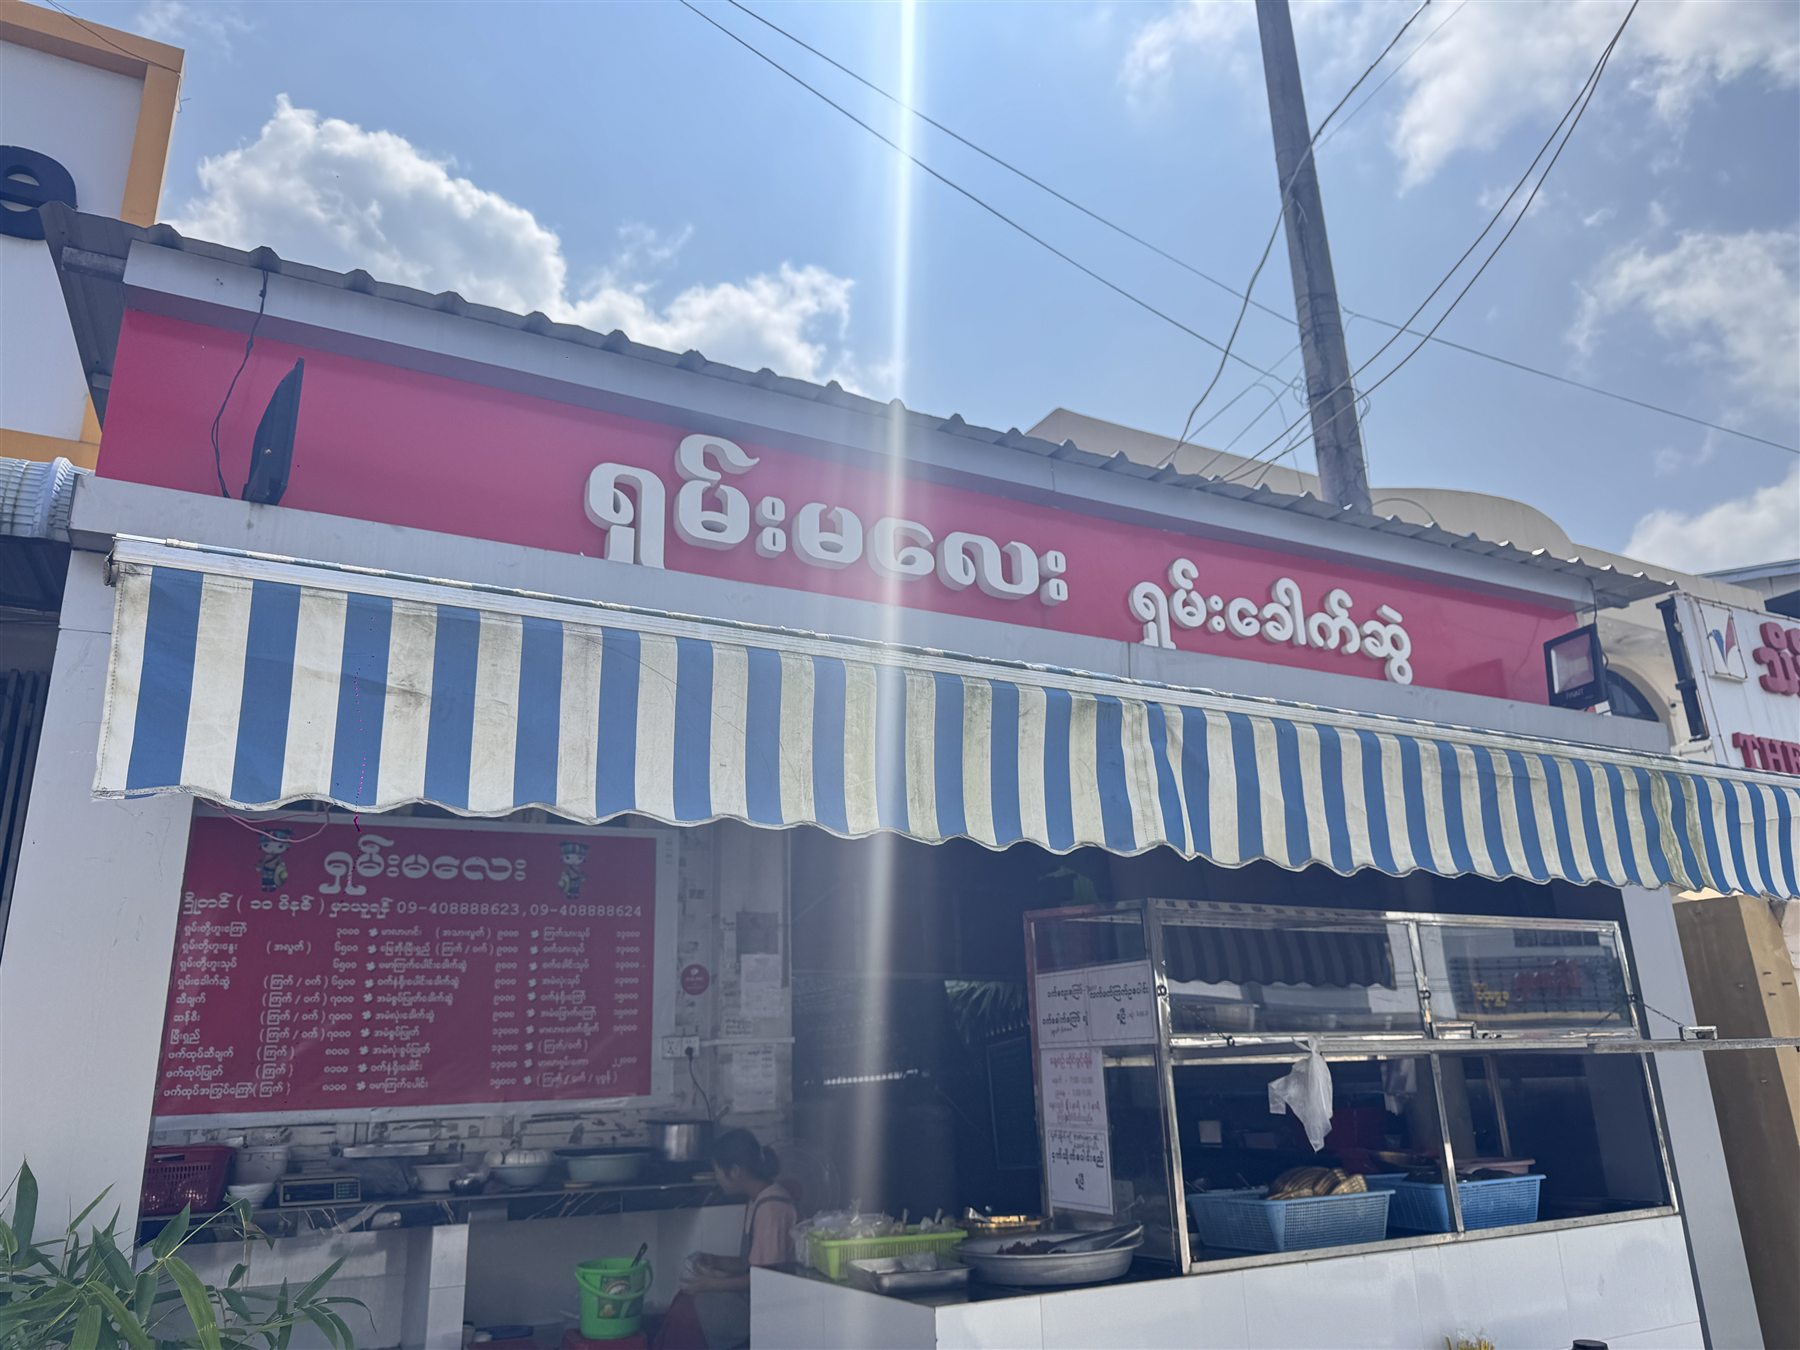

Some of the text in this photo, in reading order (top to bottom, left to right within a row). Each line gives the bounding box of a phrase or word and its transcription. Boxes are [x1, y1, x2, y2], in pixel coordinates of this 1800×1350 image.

[585, 434, 1068, 606] ရှမ်းမလေး
[1129, 558, 1413, 685] ရှမ်းခေါက်ဆွဲ
[319, 834, 527, 896] ရှမ်းမလေး
